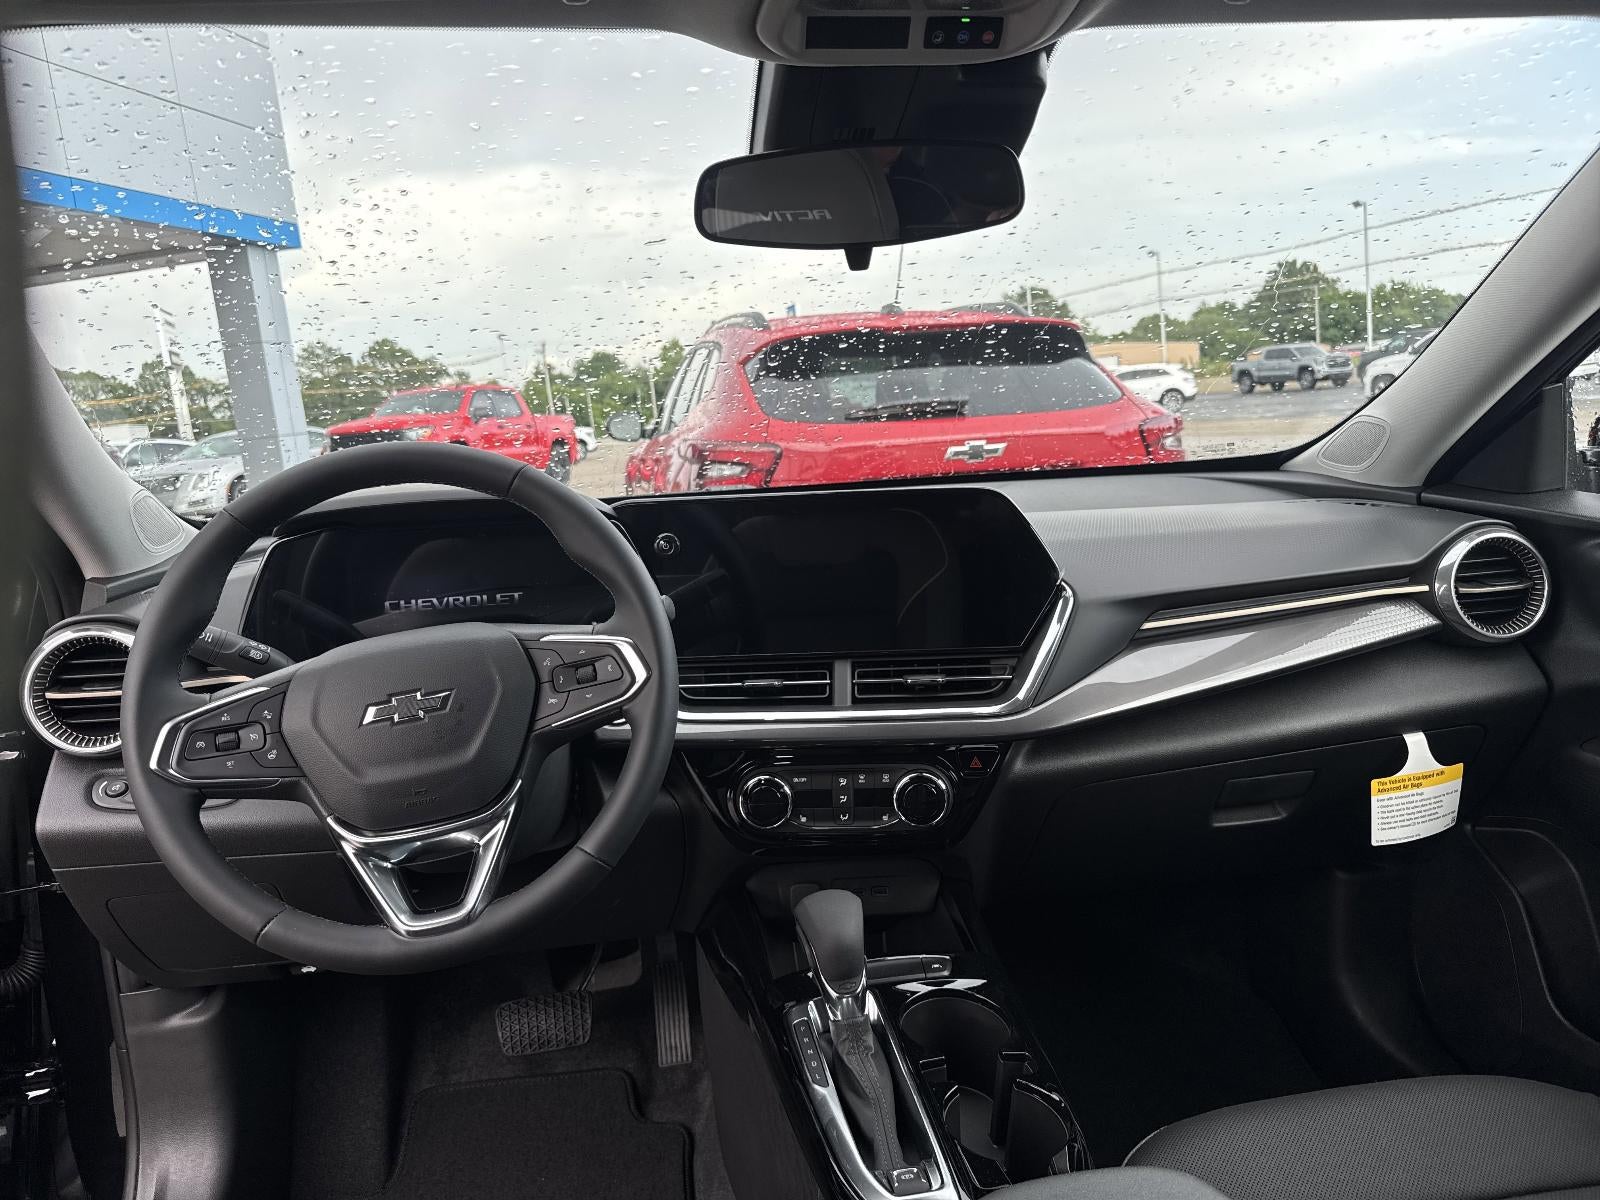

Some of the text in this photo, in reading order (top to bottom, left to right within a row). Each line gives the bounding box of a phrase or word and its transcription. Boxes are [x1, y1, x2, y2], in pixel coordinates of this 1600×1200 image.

[384, 591, 524, 613] CHEVROLET
[1412, 772, 1434, 782] Equipped
[1377, 785, 1402, 793] Advanced
